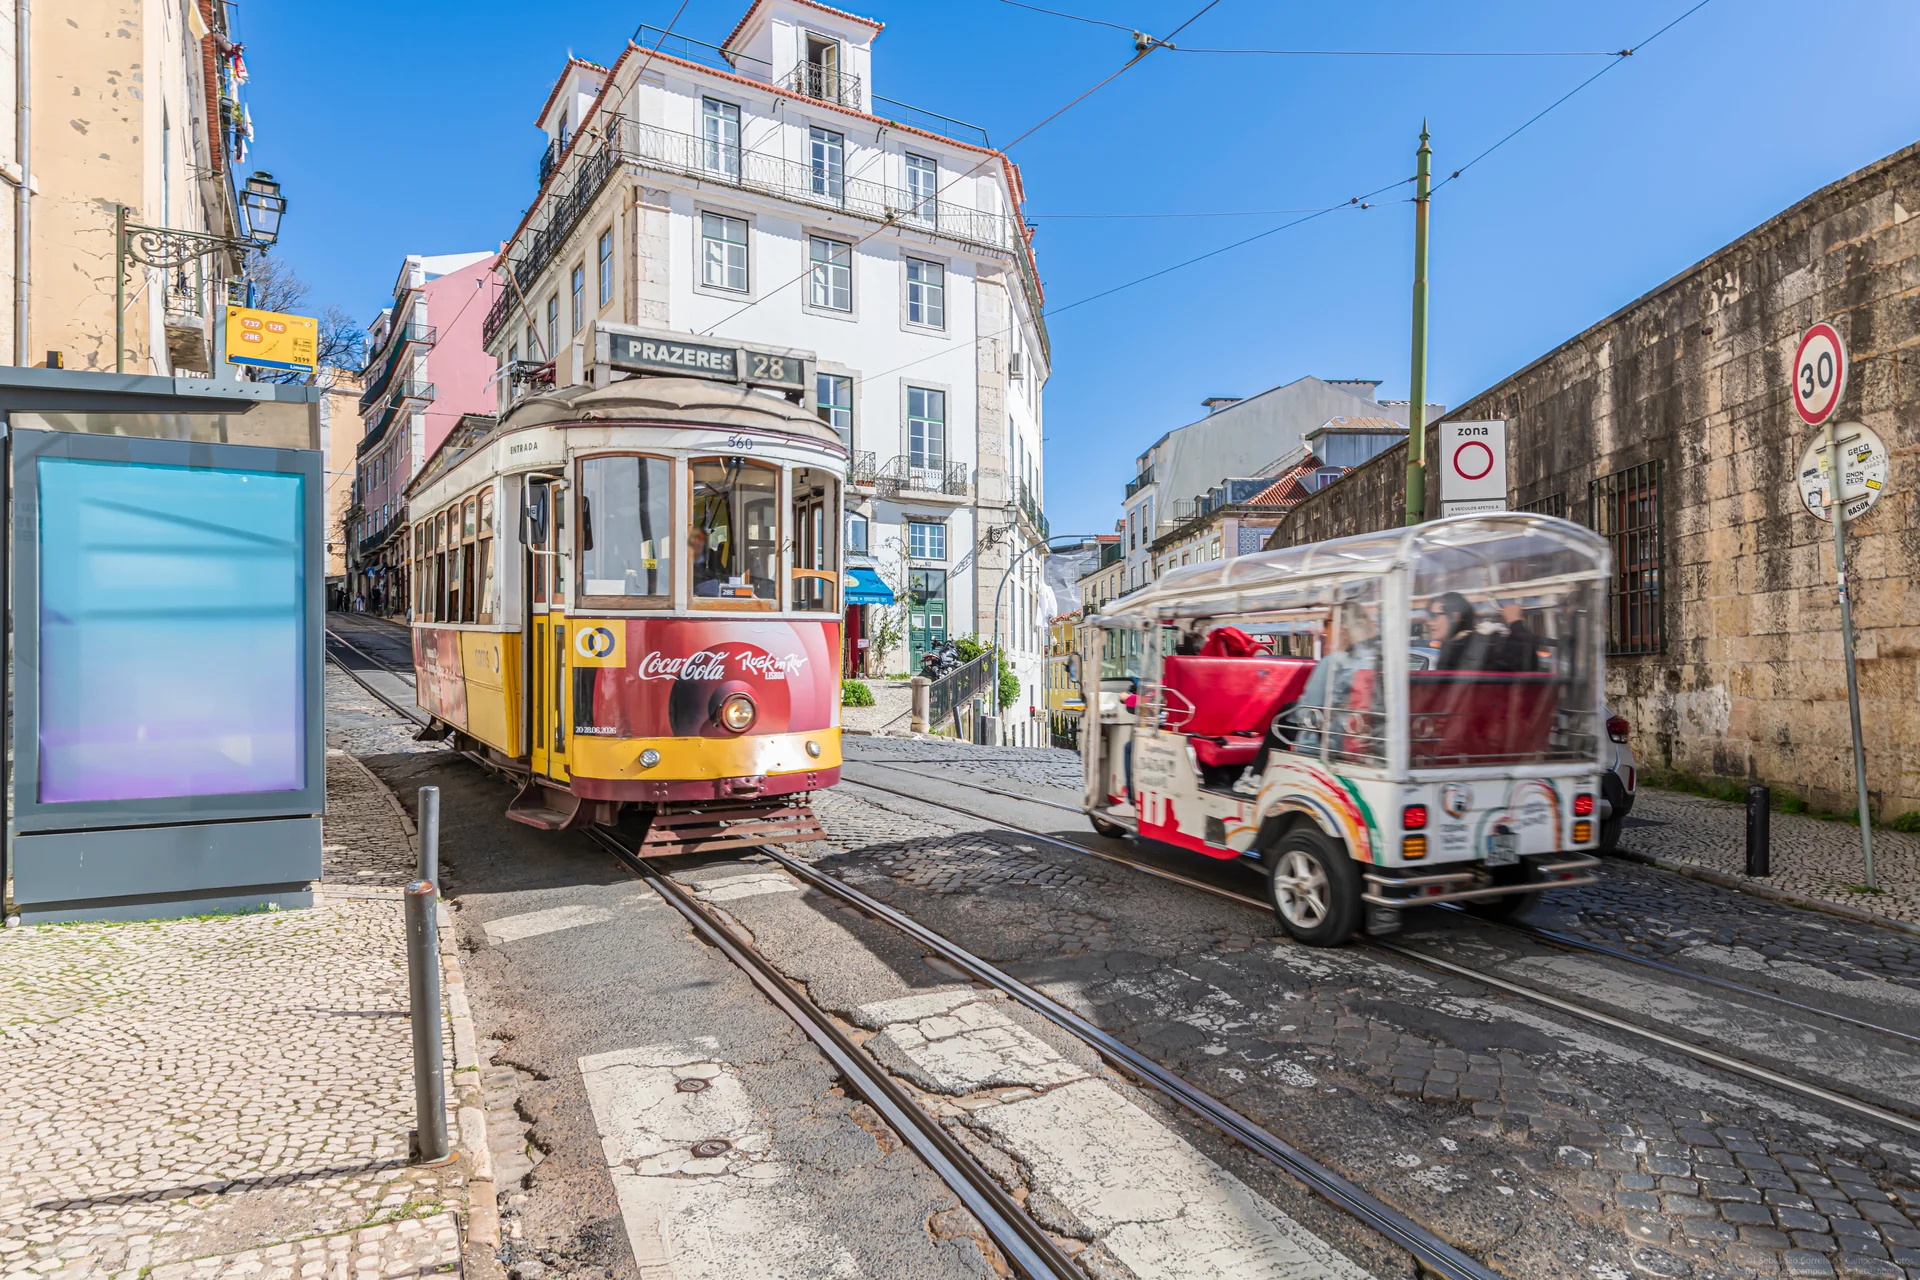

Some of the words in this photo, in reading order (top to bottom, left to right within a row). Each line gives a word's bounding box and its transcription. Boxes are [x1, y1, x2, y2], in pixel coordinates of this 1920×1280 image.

[244, 319, 260, 328] 737
[268, 323, 284, 332] 12E
[244, 333, 260, 341] 28E
[293, 356, 310, 364] 3599
[628, 340, 733, 371] PRAZERES
[753, 354, 785, 380] 28
[1800, 351, 1833, 399] 30
[1457, 427, 1489, 436] zona
[510, 441, 538, 455] ENTRADA
[727, 435, 753, 450] 560
[1847, 500, 1870, 516] RASOK
[638, 650, 730, 681] Coca-Cola
[735, 650, 772, 676] Rock
[784, 653, 808, 677] Rio
[765, 671, 785, 680] LISBOA
